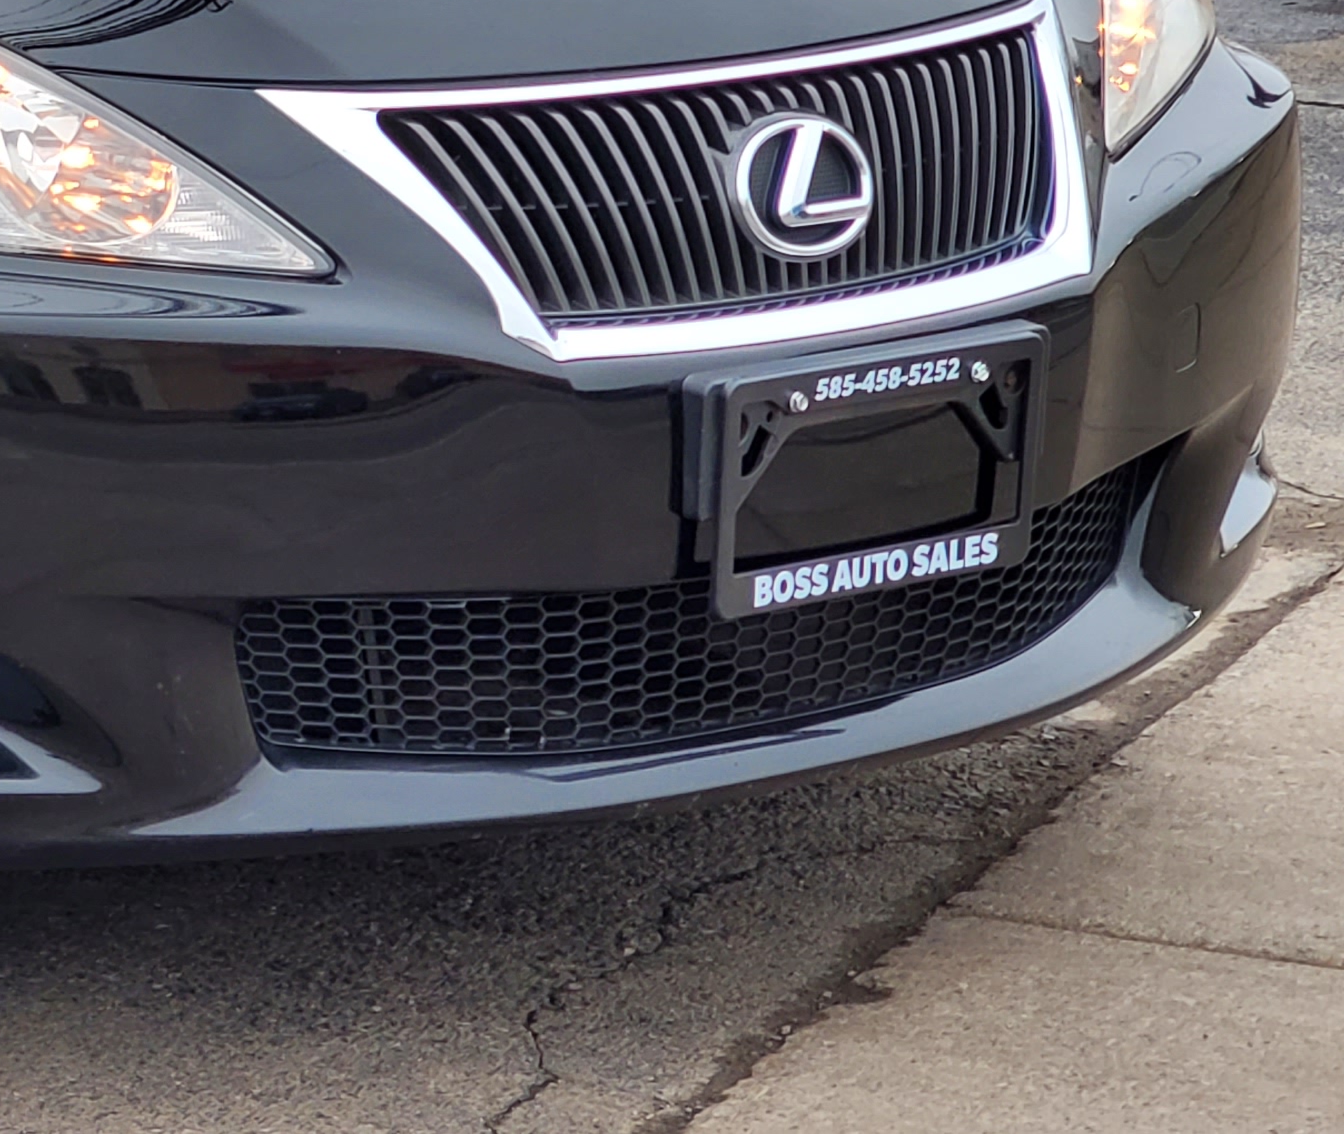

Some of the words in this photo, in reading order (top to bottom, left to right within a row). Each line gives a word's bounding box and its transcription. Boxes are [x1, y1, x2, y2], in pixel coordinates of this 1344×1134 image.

[814, 357, 961, 402] 585-458-5252
[753, 572, 830, 609] BOSS
[831, 550, 909, 593] AUTO
[911, 531, 999, 576] SALES
